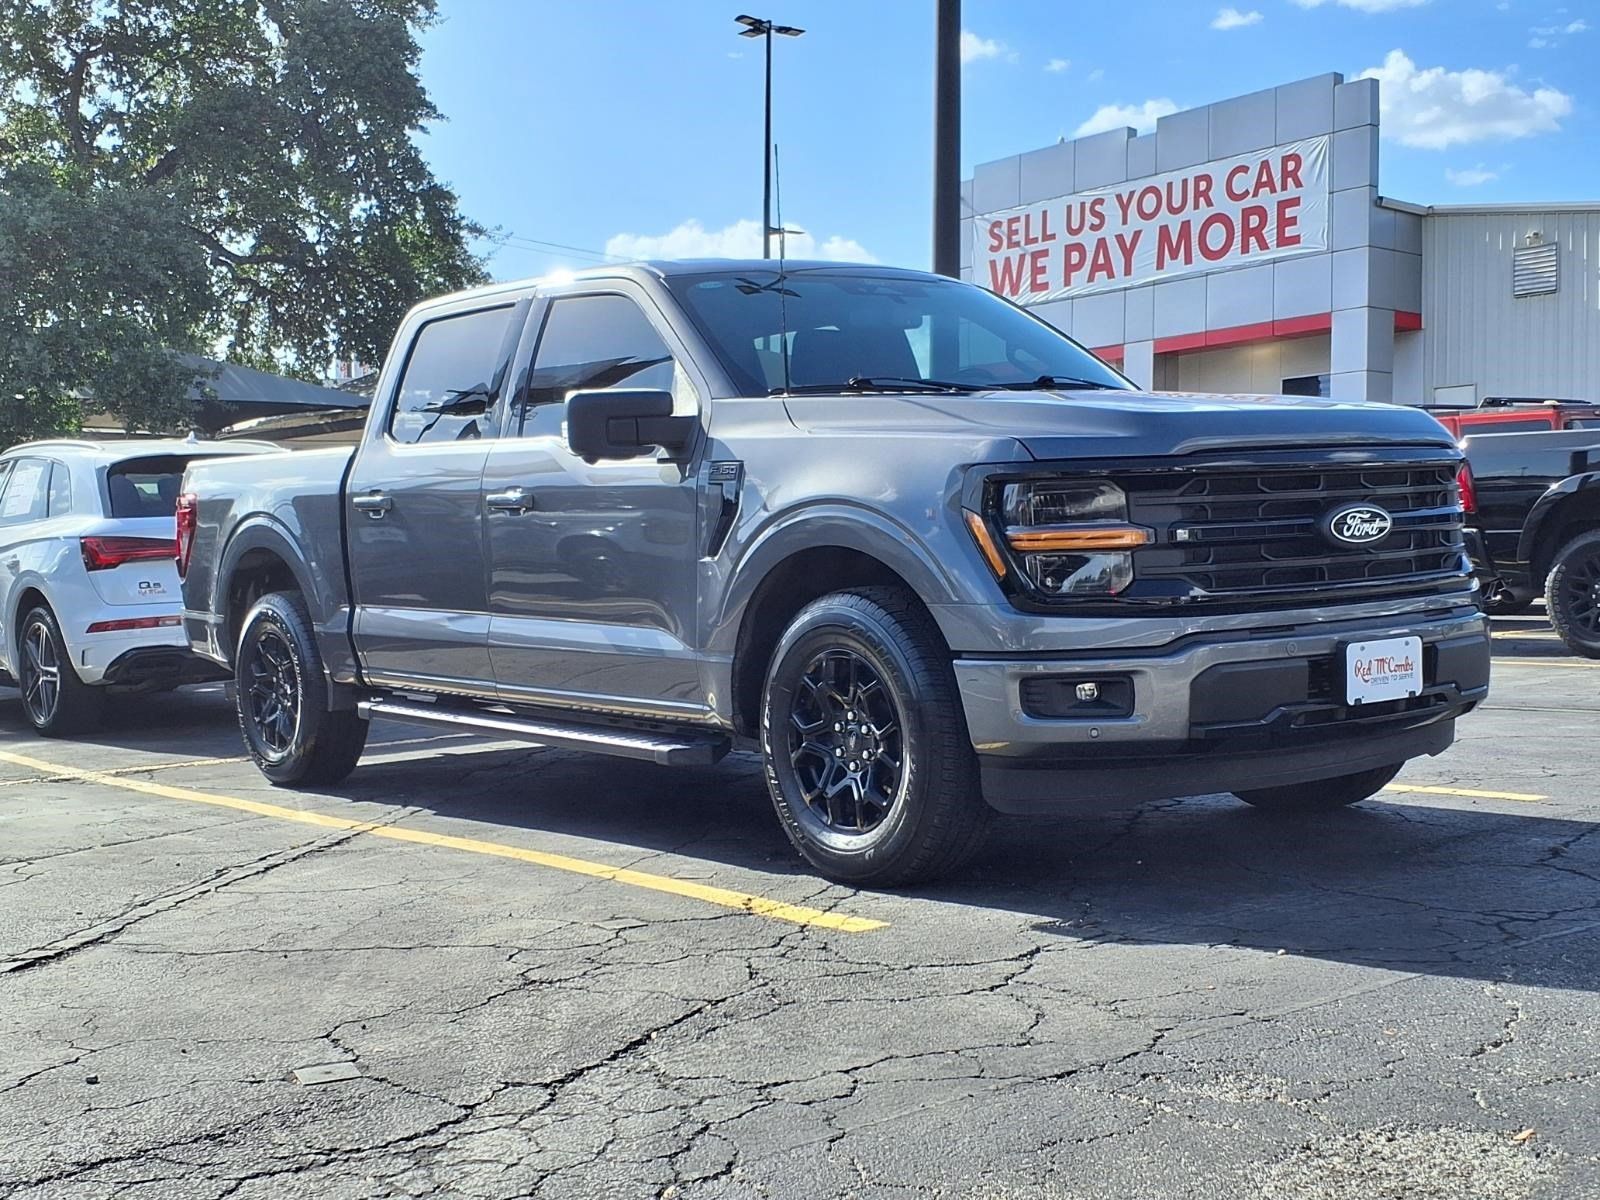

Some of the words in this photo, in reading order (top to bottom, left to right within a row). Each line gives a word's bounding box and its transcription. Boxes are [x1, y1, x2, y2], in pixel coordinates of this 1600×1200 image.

[988, 210, 1056, 252] SELL
[1066, 198, 1106, 237] US
[1115, 173, 1214, 226] YOUR
[1225, 153, 1304, 201] CAR
[989, 249, 1050, 297] WE
[1063, 229, 1143, 287] PAY
[1155, 196, 1301, 271] MORE
[1343, 512, 1380, 537] Ford
[1354, 659, 1373, 683] Red
[1373, 655, 1414, 675] McCombs
[1370, 676, 1389, 684] DRIVEN
